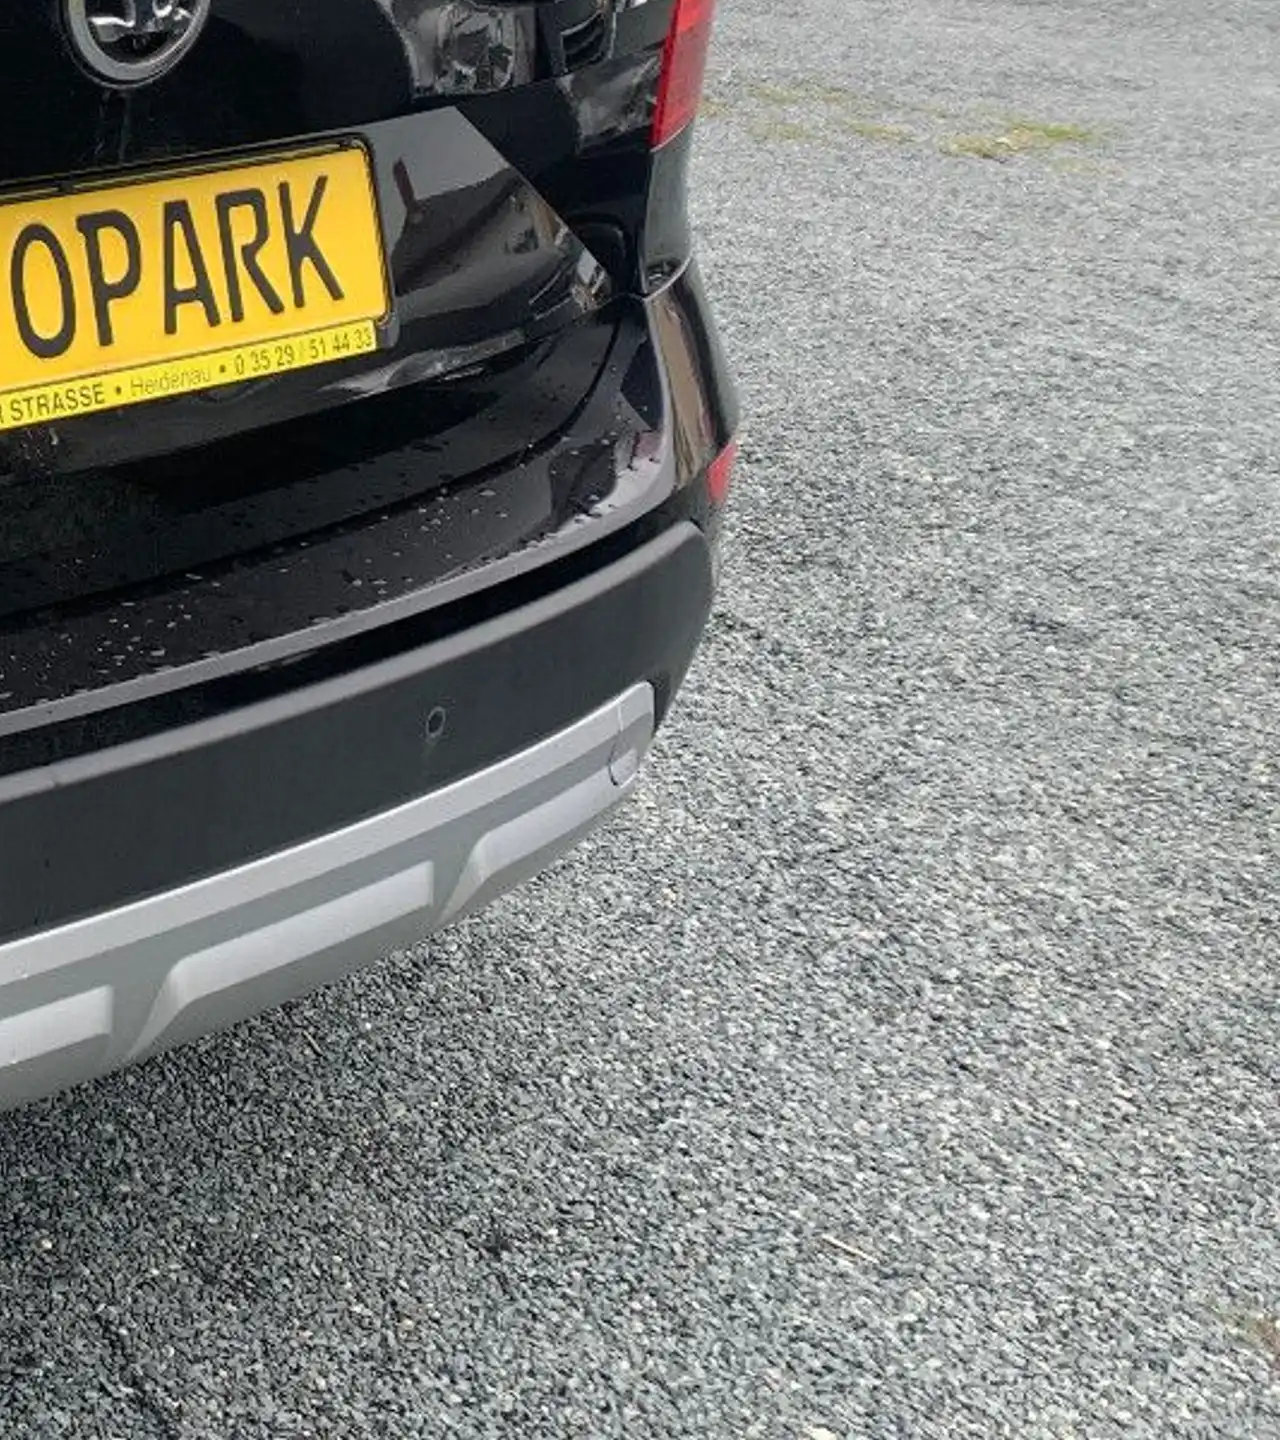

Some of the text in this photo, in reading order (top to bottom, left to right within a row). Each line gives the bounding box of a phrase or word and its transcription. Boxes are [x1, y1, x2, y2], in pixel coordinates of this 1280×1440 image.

[11, 382, 106, 422] STRASSE
[130, 368, 211, 397] Heidenau
[233, 353, 246, 376] 0
[250, 348, 272, 372] 35
[274, 343, 296, 367] 29
[308, 337, 327, 360] 51
[332, 331, 351, 353] 44
